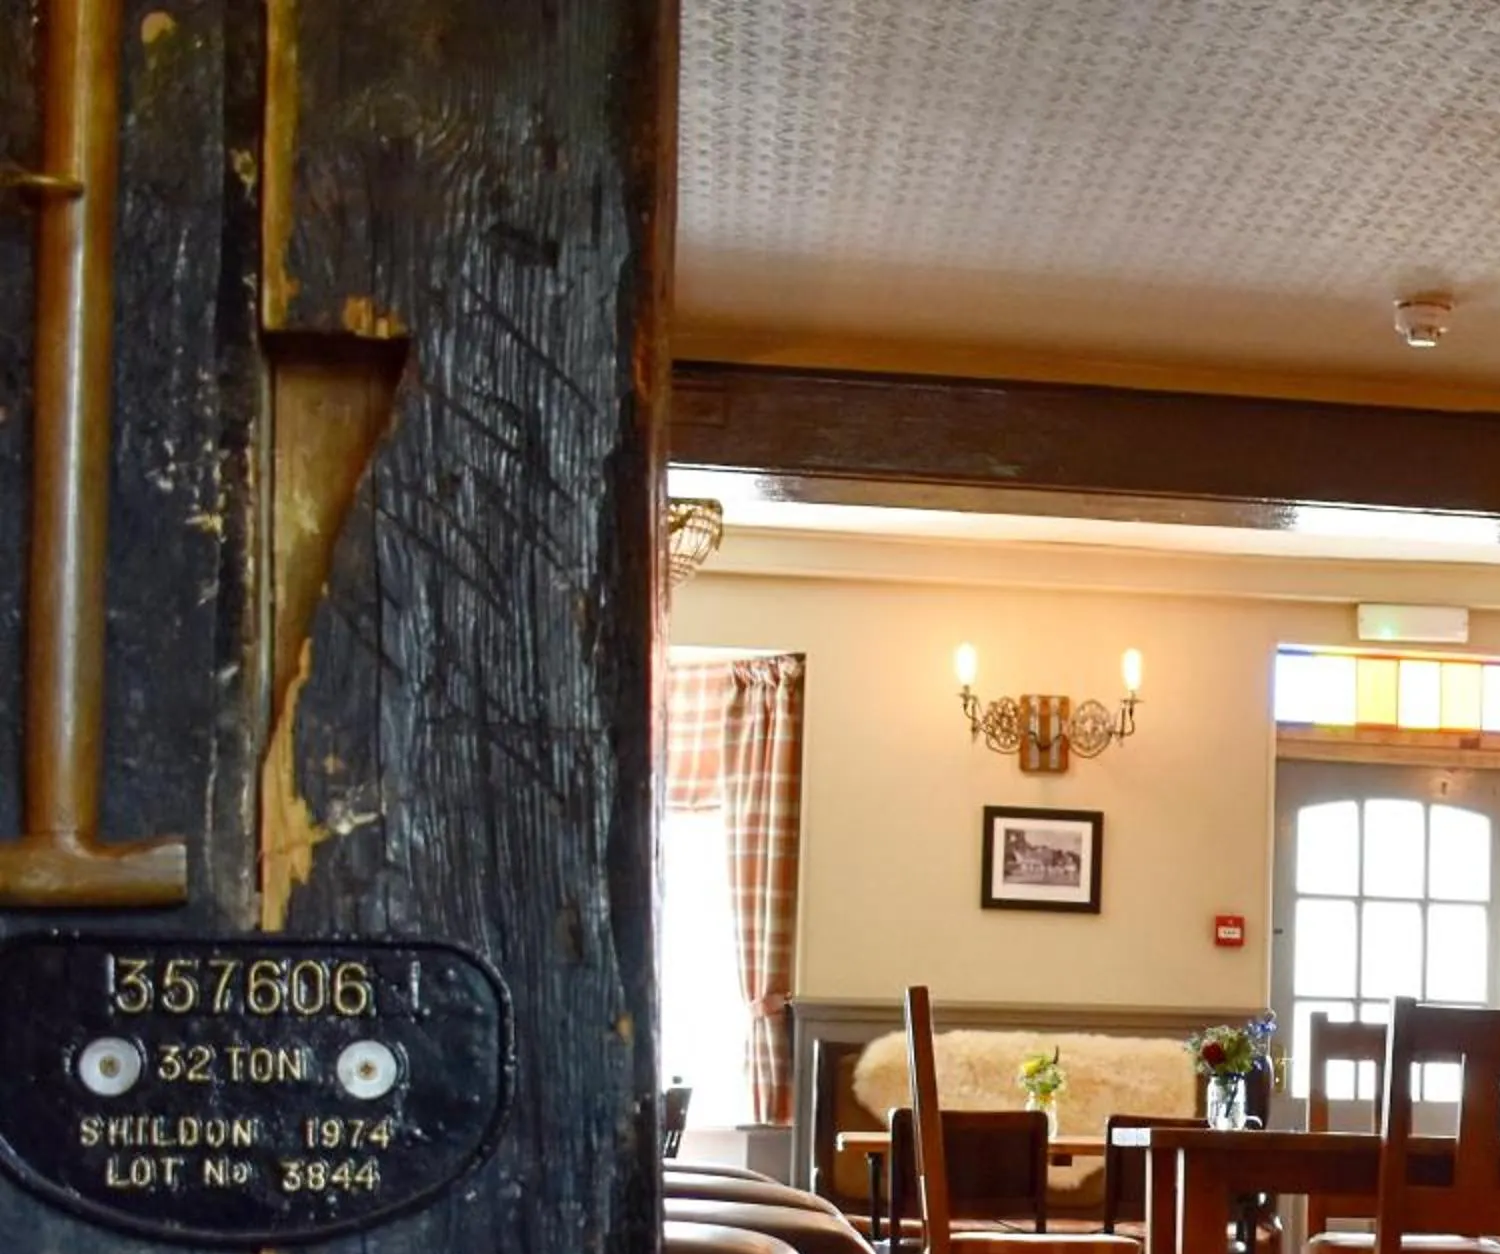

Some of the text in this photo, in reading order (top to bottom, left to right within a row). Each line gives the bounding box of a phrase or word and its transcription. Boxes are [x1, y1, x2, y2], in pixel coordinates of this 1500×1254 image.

[115, 958, 372, 1016] 357606
[158, 1046, 303, 1082] 32 TON
[80, 1117, 391, 1149] SHILDON 1974
[107, 1159, 182, 1187] LOT
[282, 1161, 377, 1191] 3844
